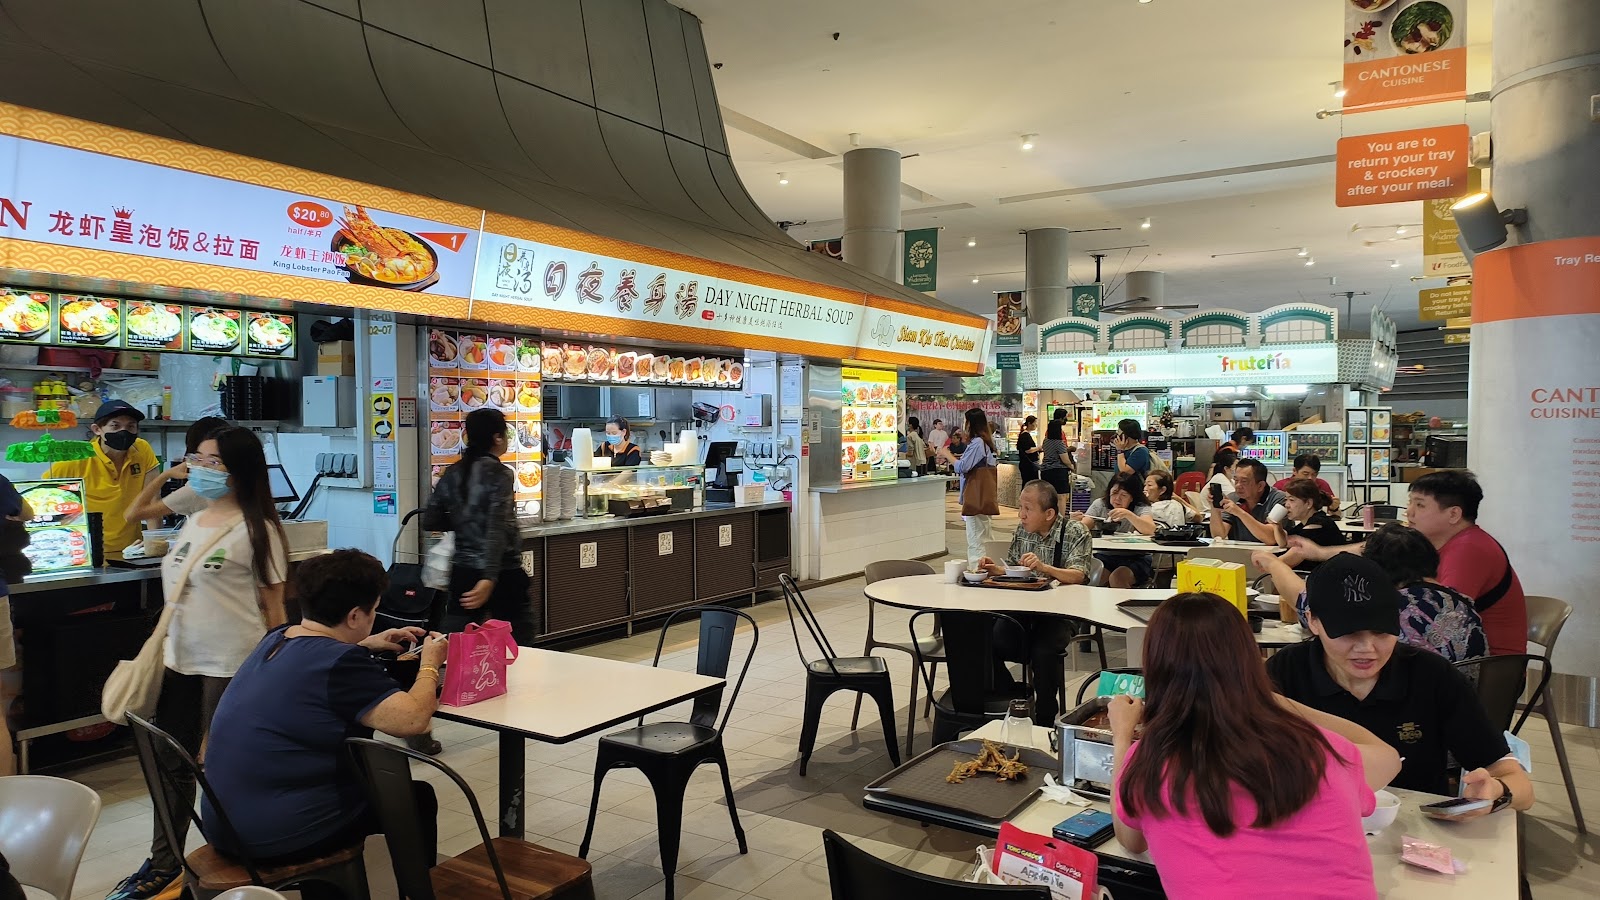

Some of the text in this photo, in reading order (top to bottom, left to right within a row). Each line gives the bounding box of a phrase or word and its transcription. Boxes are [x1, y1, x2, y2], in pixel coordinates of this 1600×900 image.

[1358, 60, 1450, 81] CANTONESE
[1382, 76, 1424, 88] CUISINE
[1368, 137, 1436, 153] You are to
[1348, 150, 1456, 169] return your tray
[1364, 166, 1438, 180] & crockery
[1347, 176, 1454, 196] after your meal.
[48, 210, 261, 262] 龙虾皇泡饭&拉面
[449, 234, 458, 248] 1
[1554, 254, 1600, 266] Tray Re
[273, 260, 291, 270] King
[292, 264, 321, 273] Lobster
[336, 270, 350, 278] Fan
[704, 286, 854, 325] DAY NIGHT HERBAL SOUP
[1423, 303, 1452, 312] crockery
[368, 325, 392, 336] 02-07
[1530, 388, 1600, 404] CANT
[1530, 408, 1600, 418] CUISINE
[1020, 866, 1050, 883] Apple
[1056, 862, 1082, 878] Daily Pack
